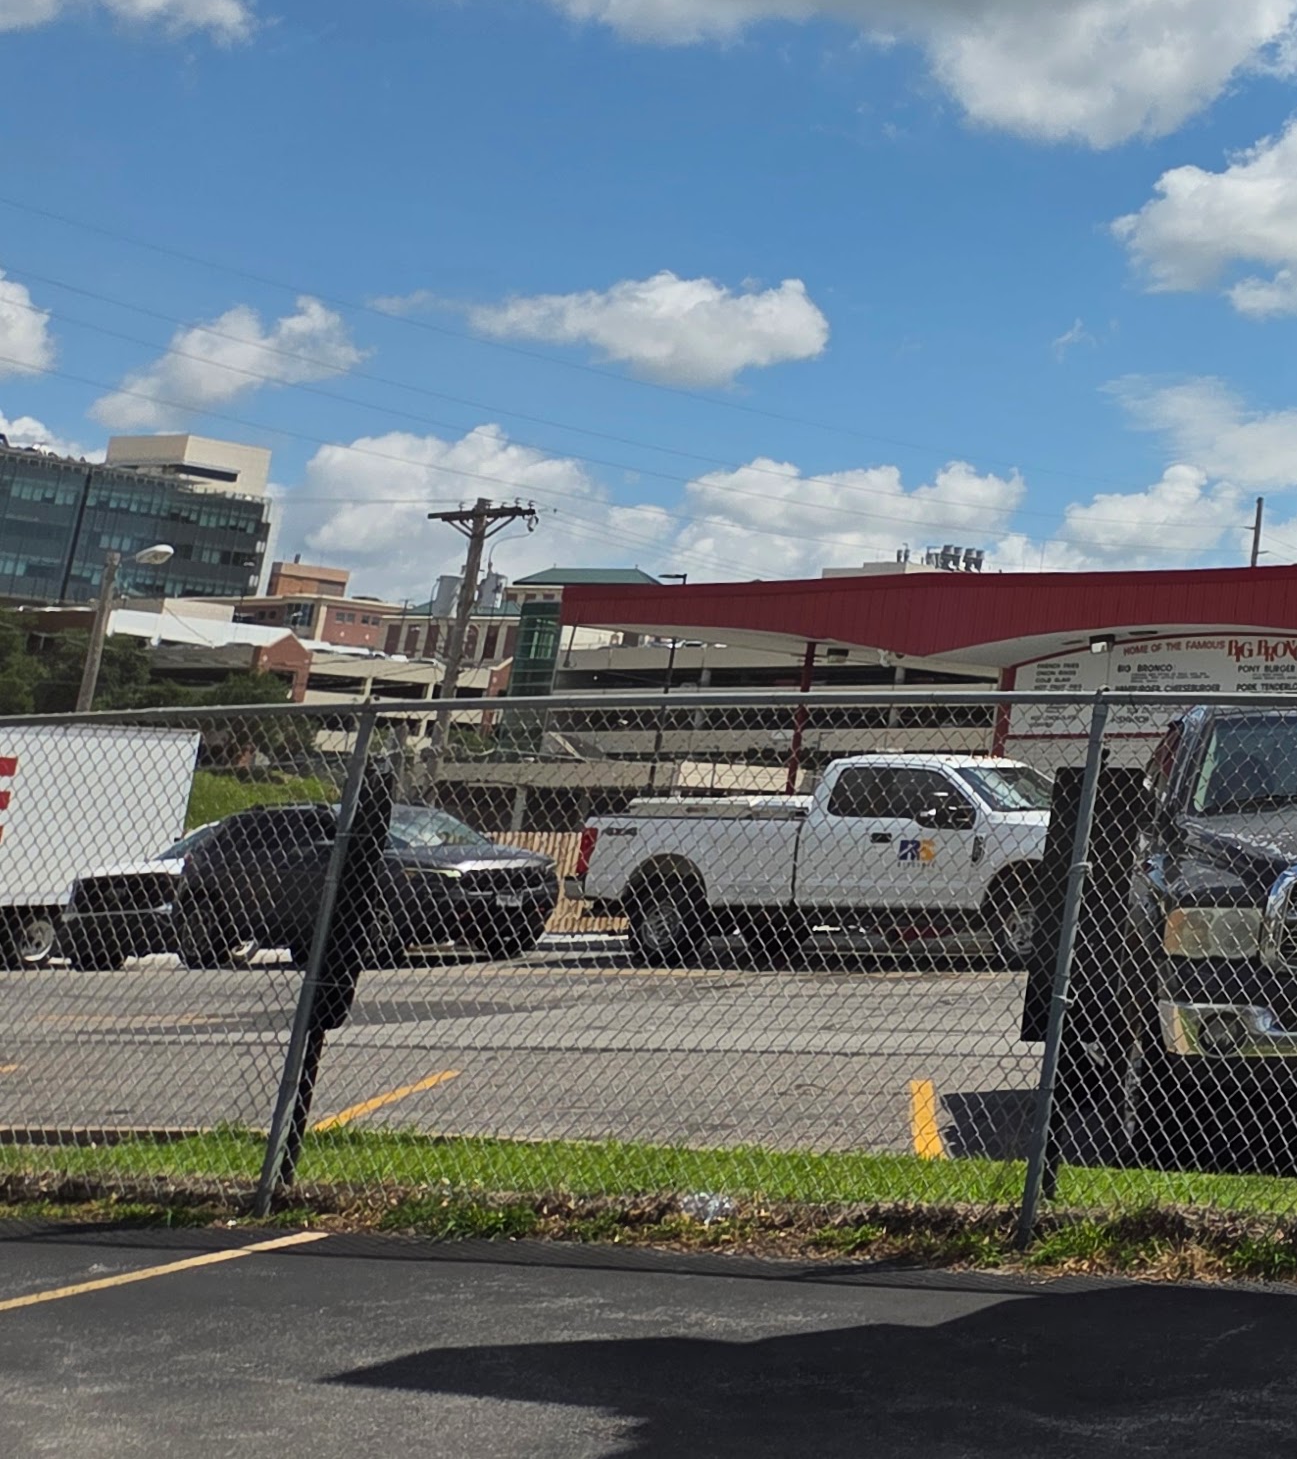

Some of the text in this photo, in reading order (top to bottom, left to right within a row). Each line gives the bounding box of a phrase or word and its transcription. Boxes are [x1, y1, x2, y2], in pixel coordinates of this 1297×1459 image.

[1124, 640, 1226, 655] HOME OF THE FAMOUS
[1227, 640, 1254, 662] BIG
[1137, 663, 1173, 672] BRONCO
[1238, 664, 1296, 673] PONY BURGER
